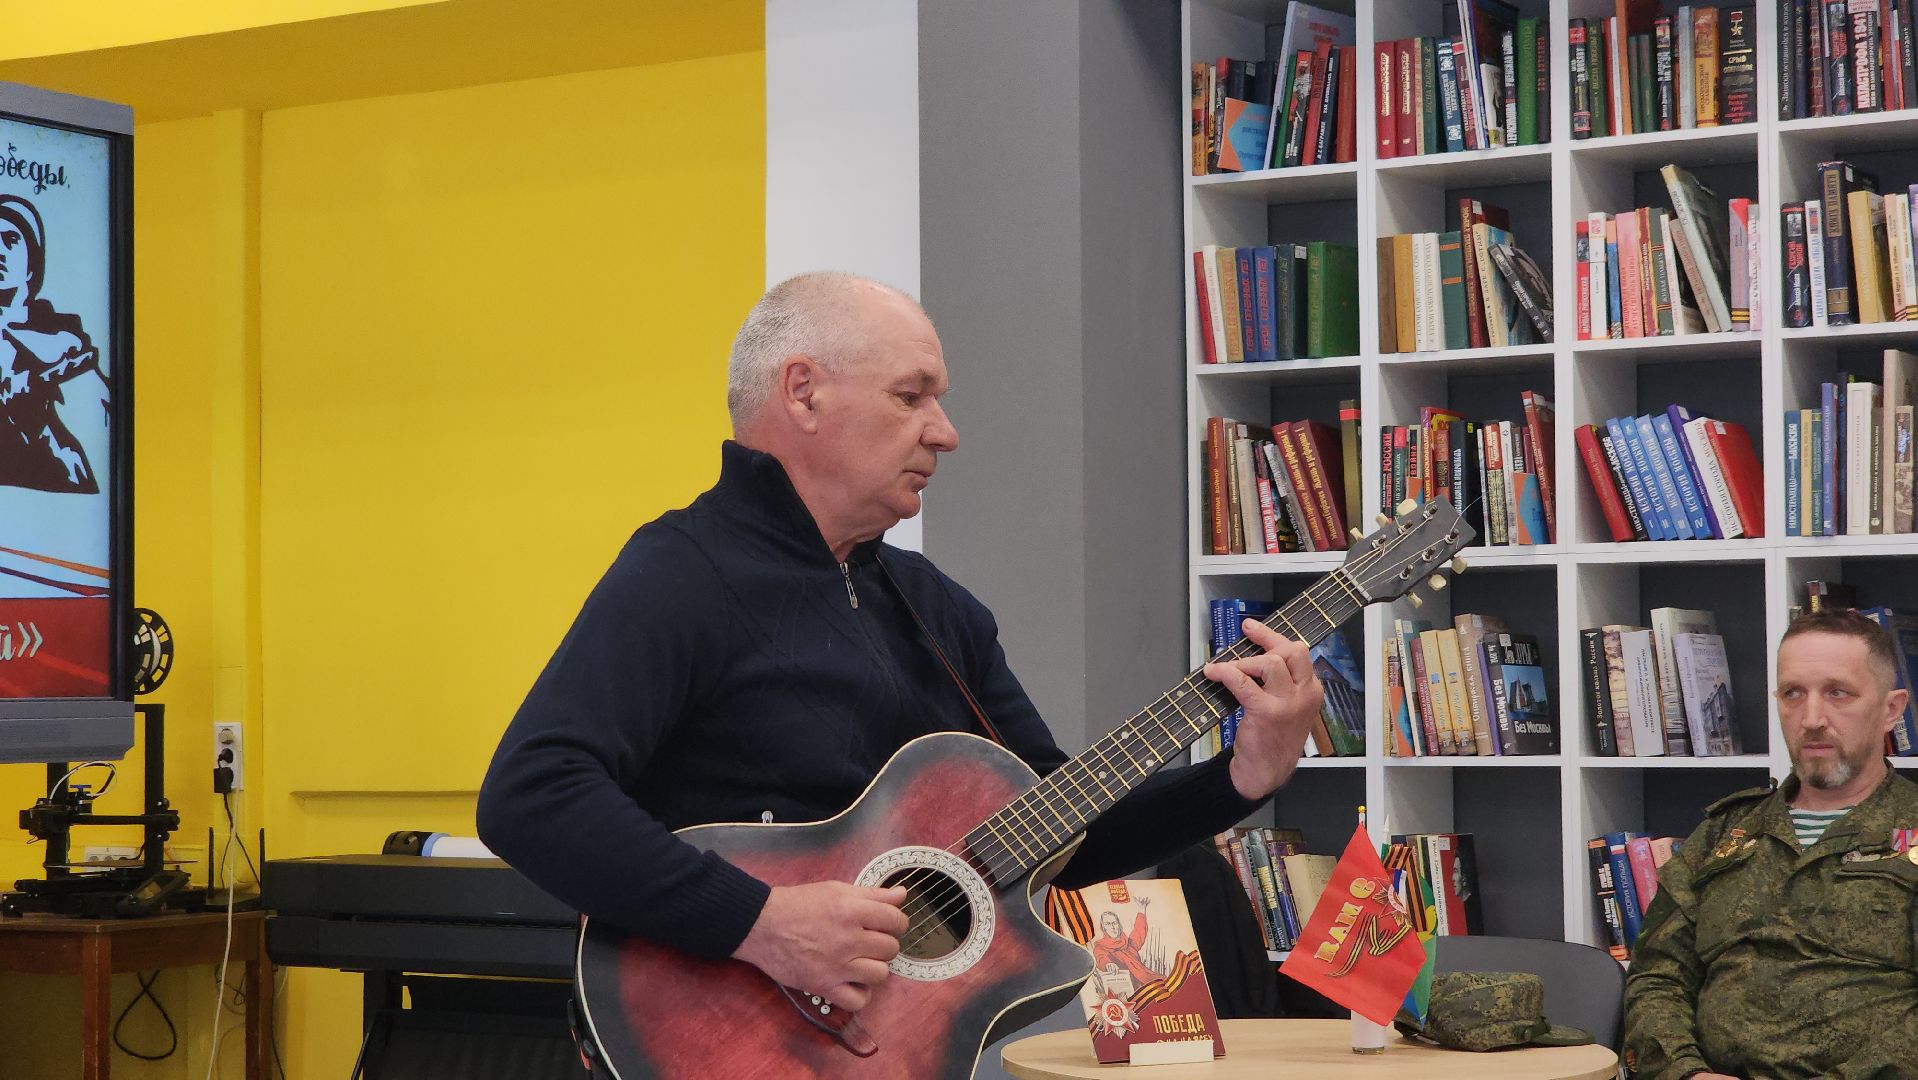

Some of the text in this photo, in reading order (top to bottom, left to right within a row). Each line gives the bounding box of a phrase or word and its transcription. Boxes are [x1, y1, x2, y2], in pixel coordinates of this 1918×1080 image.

[1664, 51, 1672, 70] Т-34
[1854, 12, 1870, 108] КАТАСТРОФА 1941
[1441, 74, 1453, 119] ТАЛЛИНСКИЙ
[1826, 175, 1839, 234] КНИГА ПАМЯТИ
[1240, 258, 1249, 274] ЛЕТ
[1281, 435, 1299, 464] реформы
[1297, 432, 1315, 461] реформы
[1383, 433, 1392, 472] РОССИИ
[1663, 437, 1682, 471] МОСКВЫ
[1788, 423, 1798, 459] МОСКВЕ
[1292, 468, 1306, 491] Жизнь
[1309, 467, 1322, 488] Жизнь
[1615, 439, 1650, 512] ИСТОРИЯ МОСКВЫ
[1628, 438, 1664, 512] ИСТОРИЯ МОСКВЫ
[1645, 438, 1679, 508] ИСТОРИЯ МОСКВЫ
[1695, 421, 1738, 532] ИСТОРИЯ ГОРОДА МОСКВЫ
[1621, 485, 1643, 531] ИНОСТРАНЦЫ
[1678, 474, 1698, 512] ИСТОРИЯ
[1789, 479, 1798, 529] ИНОСТРАНЦЫ
[1309, 517, 1322, 540] Михаил
[1325, 516, 1338, 540] Михаил
[1589, 640, 1603, 719] Золотое кольцо России
[1493, 679, 1509, 731] Без Москвы
[1514, 720, 1551, 734] Без Москвы
[1618, 859, 1636, 918] ИСТОРИЯ ПОЛЬШИ
[1153, 1013, 1206, 1034] ПОБЕДА
